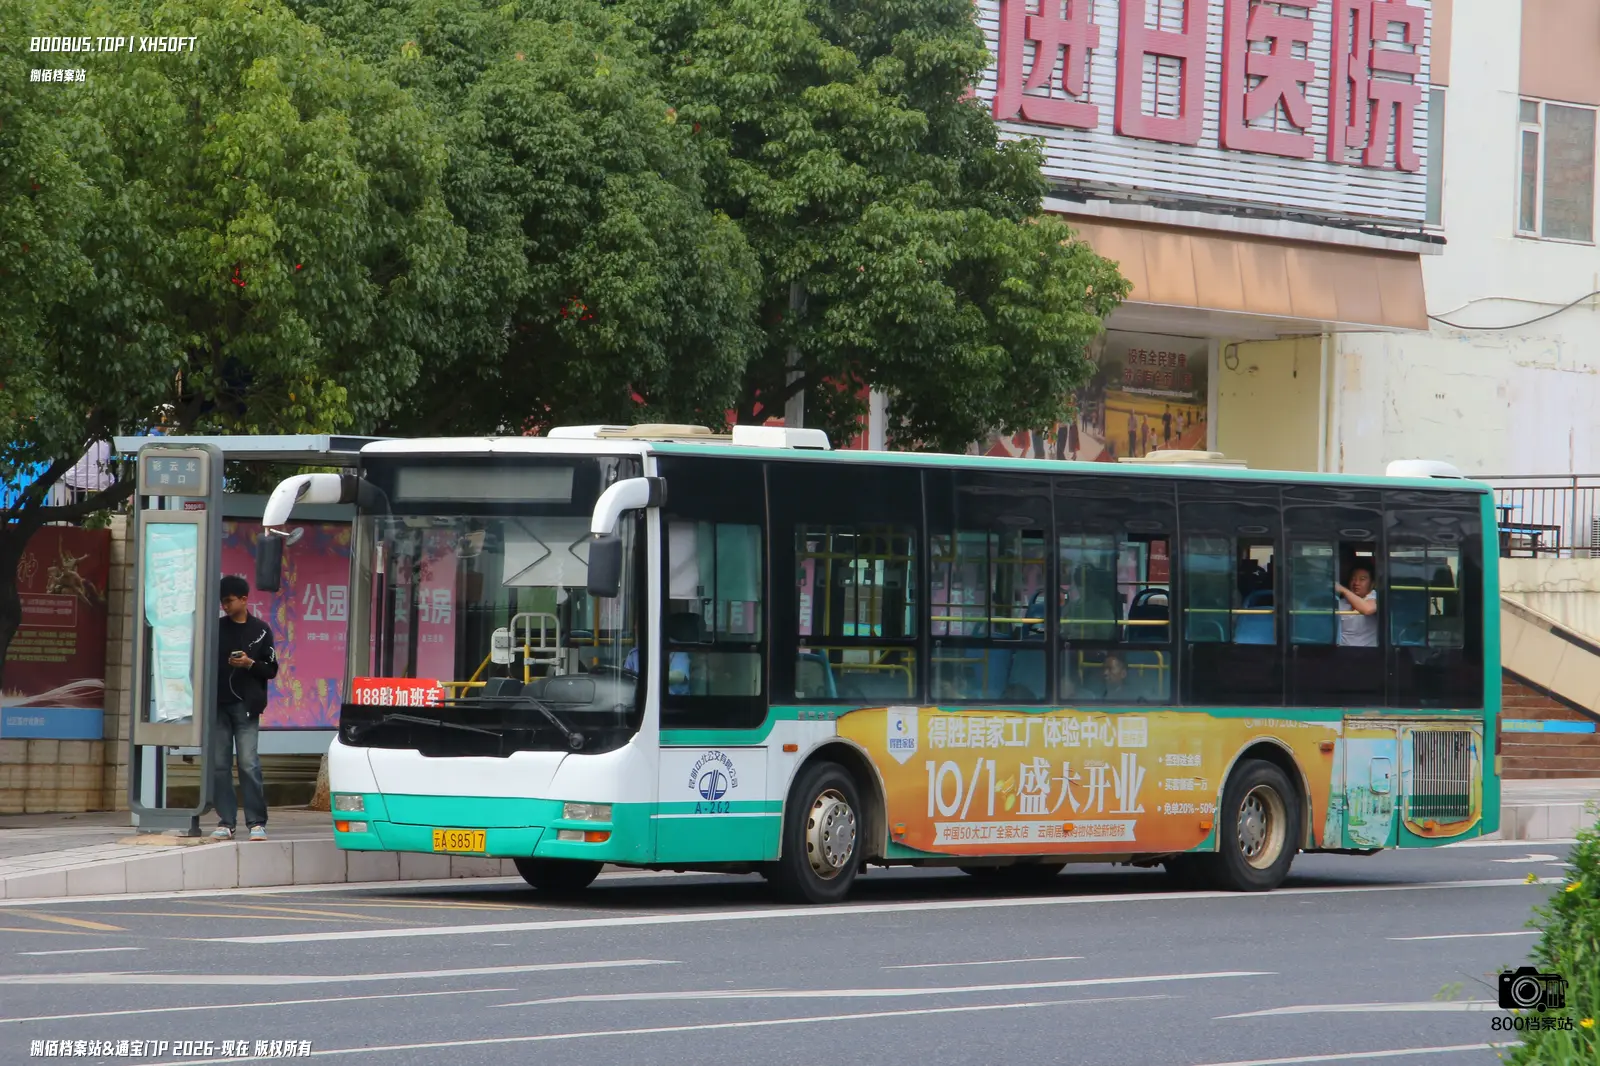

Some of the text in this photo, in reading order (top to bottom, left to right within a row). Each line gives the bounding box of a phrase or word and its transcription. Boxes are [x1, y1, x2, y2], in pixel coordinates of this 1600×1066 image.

[355, 687, 440, 707] 188路加班车
[928, 716, 1117, 749] 得胜居家工厂体验中心
[925, 752, 1146, 819] 10/1 盛大开业
[943, 826, 1029, 840] 中国50大工厂全案大店
